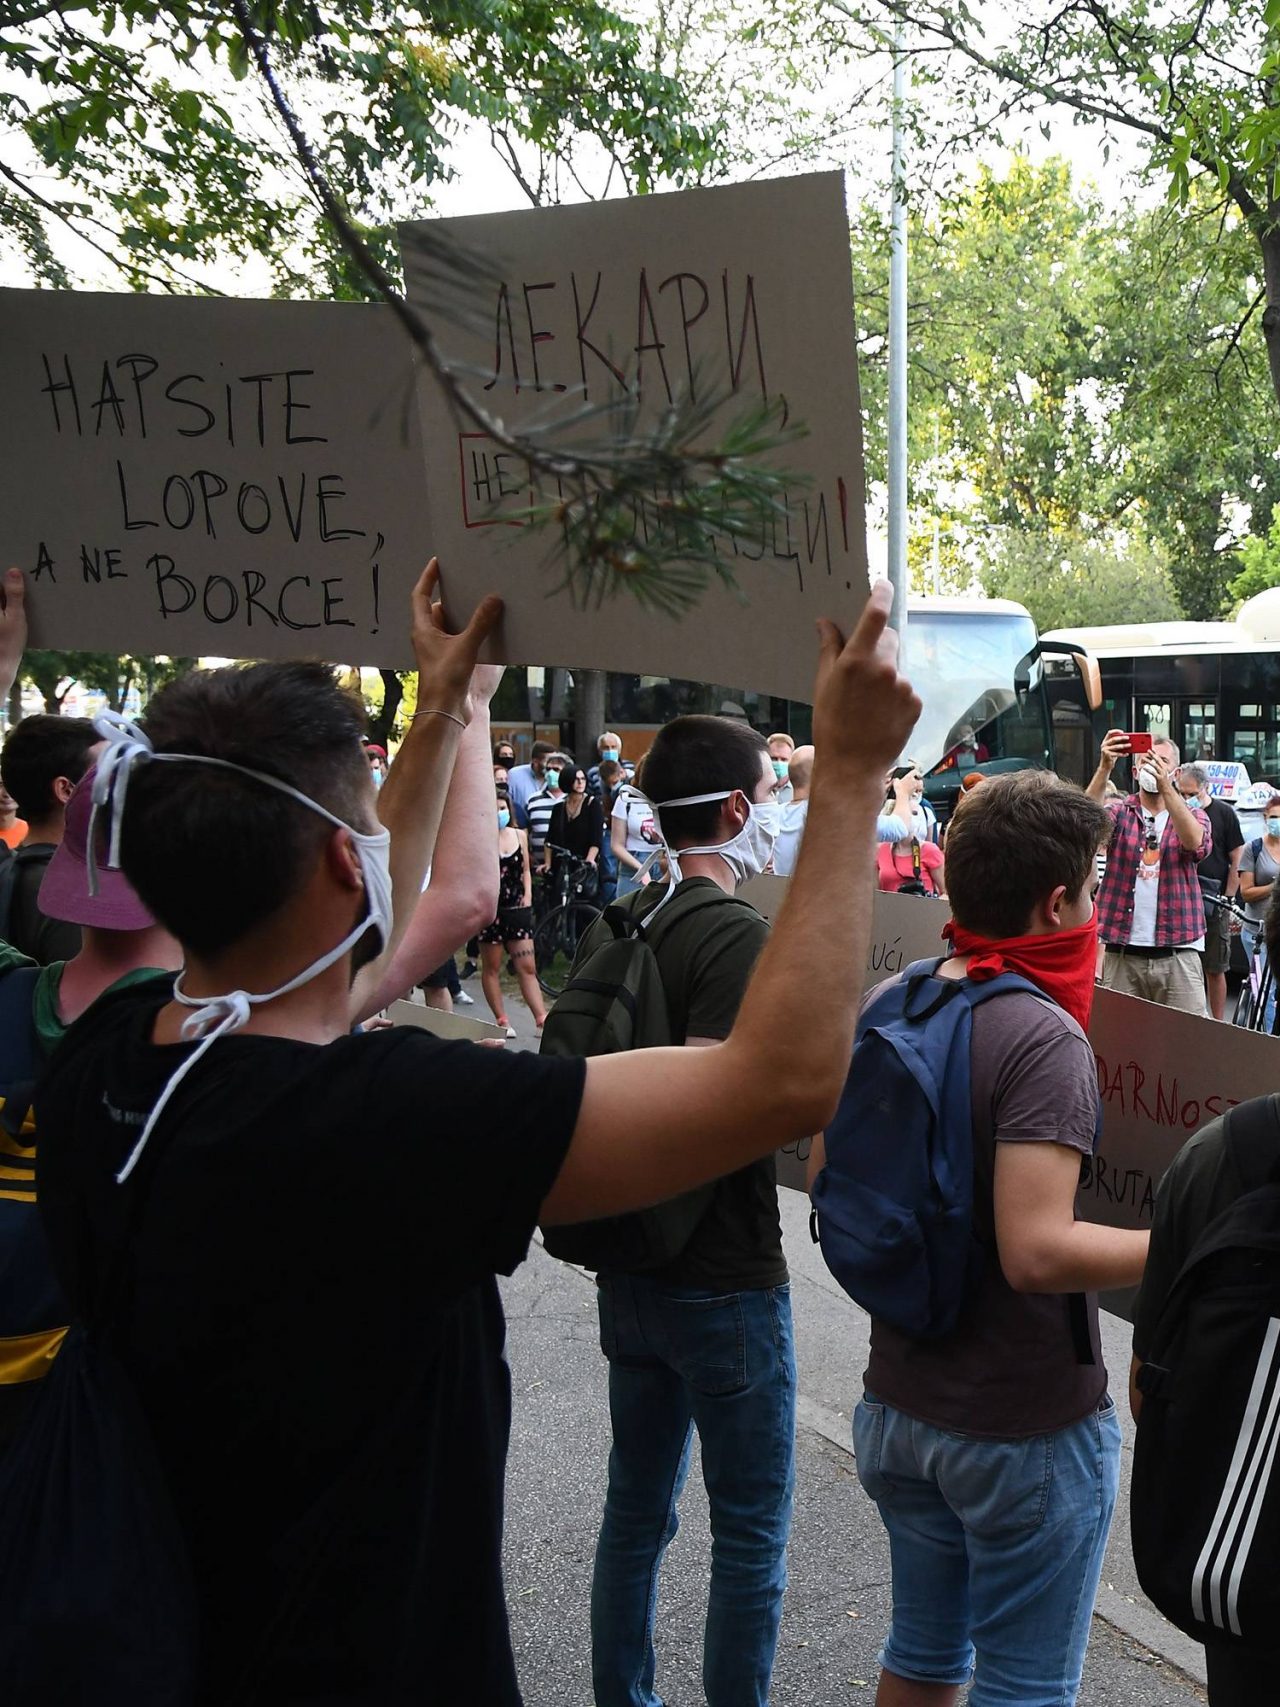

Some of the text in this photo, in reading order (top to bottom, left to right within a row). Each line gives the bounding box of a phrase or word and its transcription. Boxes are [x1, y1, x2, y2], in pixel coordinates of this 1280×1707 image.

[117, 460, 385, 559] LOPOVE,
[30, 541, 379, 634] A NE BORCE!
[1208, 764, 1240, 778] 50-400
[866, 936, 903, 974] UĆI
[1094, 1054, 1241, 1130] DARNOS
